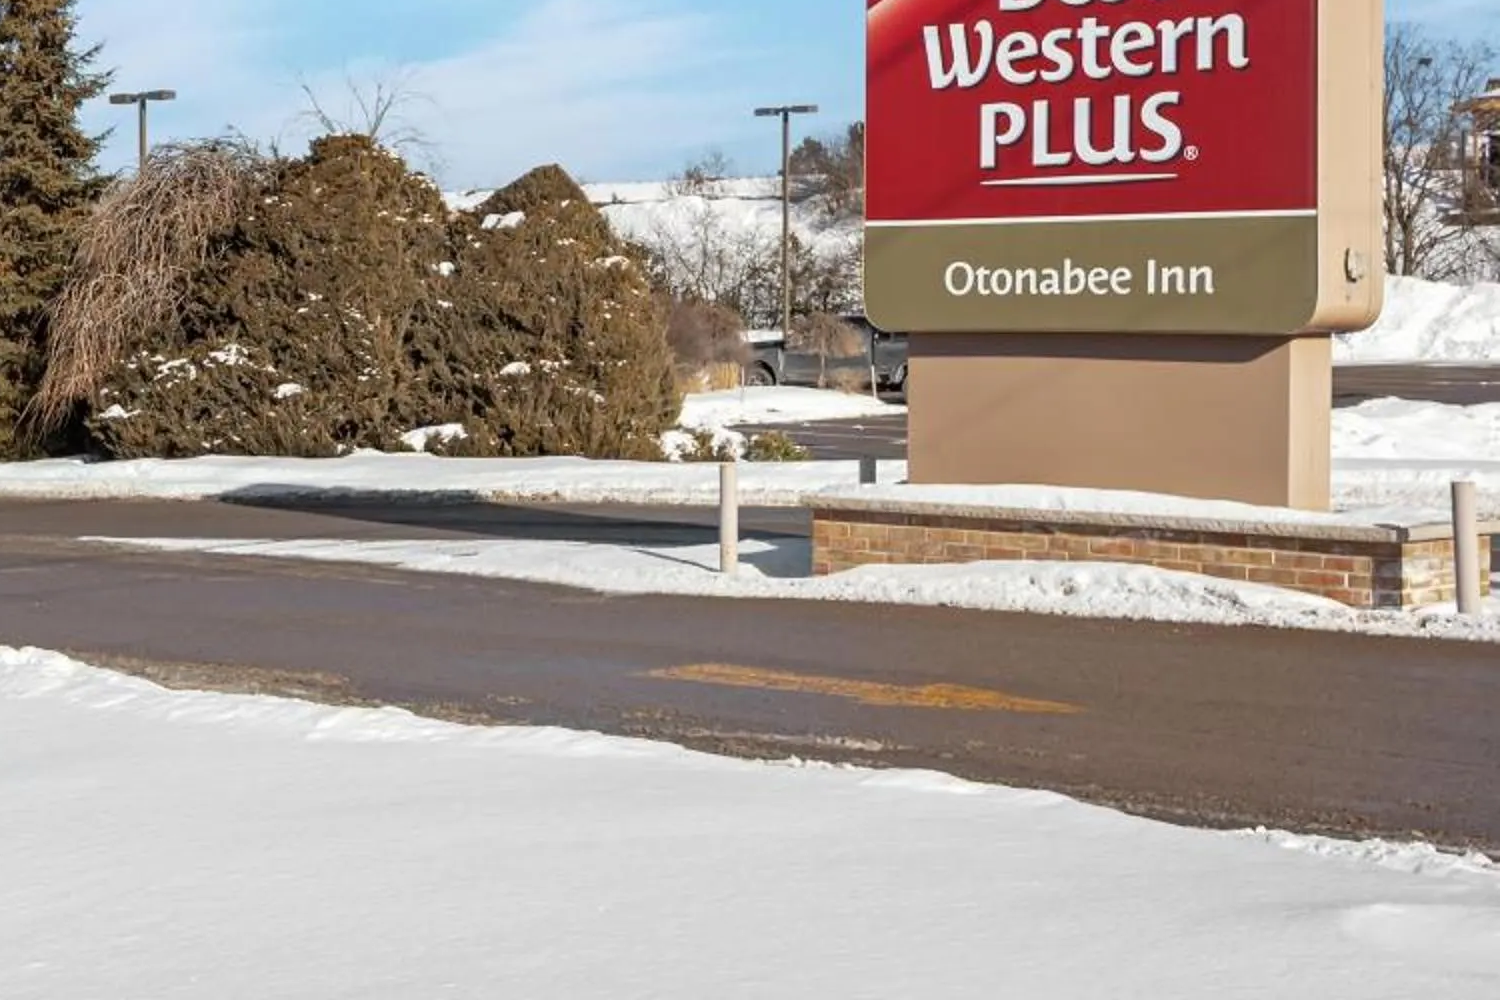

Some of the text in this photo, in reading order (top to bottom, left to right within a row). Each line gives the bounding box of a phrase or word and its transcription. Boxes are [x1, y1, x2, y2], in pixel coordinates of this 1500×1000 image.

[923, 13, 1250, 90] Western
[980, 92, 1184, 169] PLUS
[944, 258, 1215, 297] Otonabee Inn
